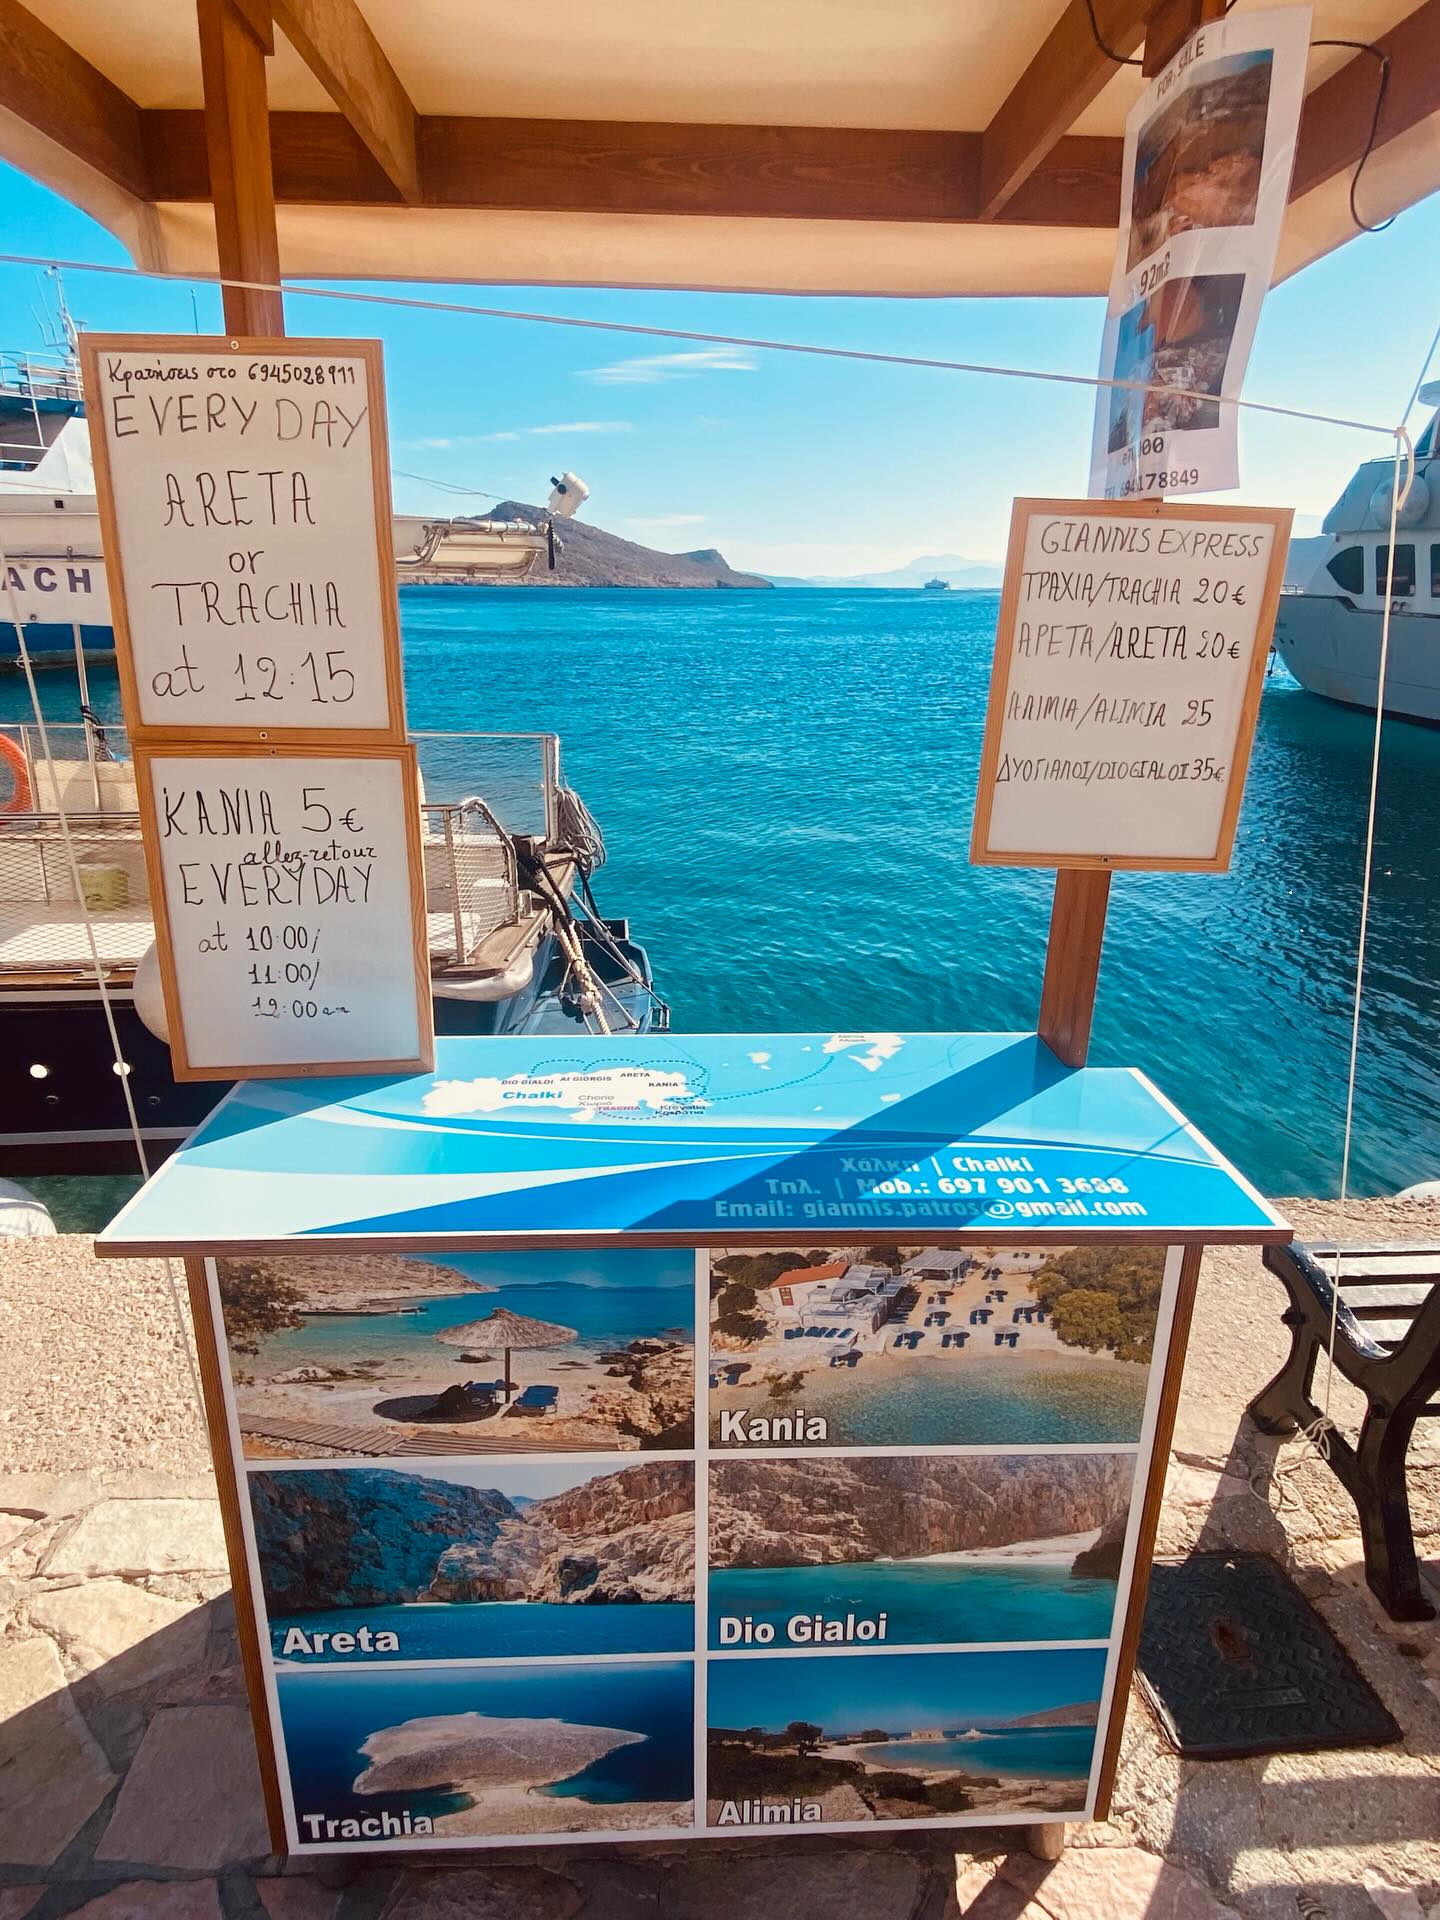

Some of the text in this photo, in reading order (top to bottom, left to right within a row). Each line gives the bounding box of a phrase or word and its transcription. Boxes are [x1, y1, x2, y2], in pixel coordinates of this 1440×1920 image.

[207, 366, 237, 380] στο
[248, 362, 355, 386] 6945028911
[113, 392, 368, 448] EVERY DAY
[163, 470, 316, 527] ARETA
[1040, 521, 1264, 558] GIANNIS EXPRESS
[228, 551, 265, 574] or
[151, 581, 347, 628] TRACHIA
[151, 644, 355, 703] at 12:15
[1181, 699, 1215, 727] 25
[163, 788, 281, 837] KANIA
[198, 921, 228, 953] at
[502, 1091, 563, 1099] Chalki
[953, 1157, 1034, 1172] Chalki
[937, 1177, 988, 1194] 697
[996, 1177, 1051, 1194] 901
[1060, 1177, 1129, 1194] 3688
[714, 1200, 793, 1217] Email:
[719, 1408, 828, 1442] Kania
[282, 1625, 400, 1655] Areta
[719, 1612, 888, 1645] Dio Gialoi
[302, 1810, 434, 1839] Trachia
[717, 1797, 822, 1825] Alimia
